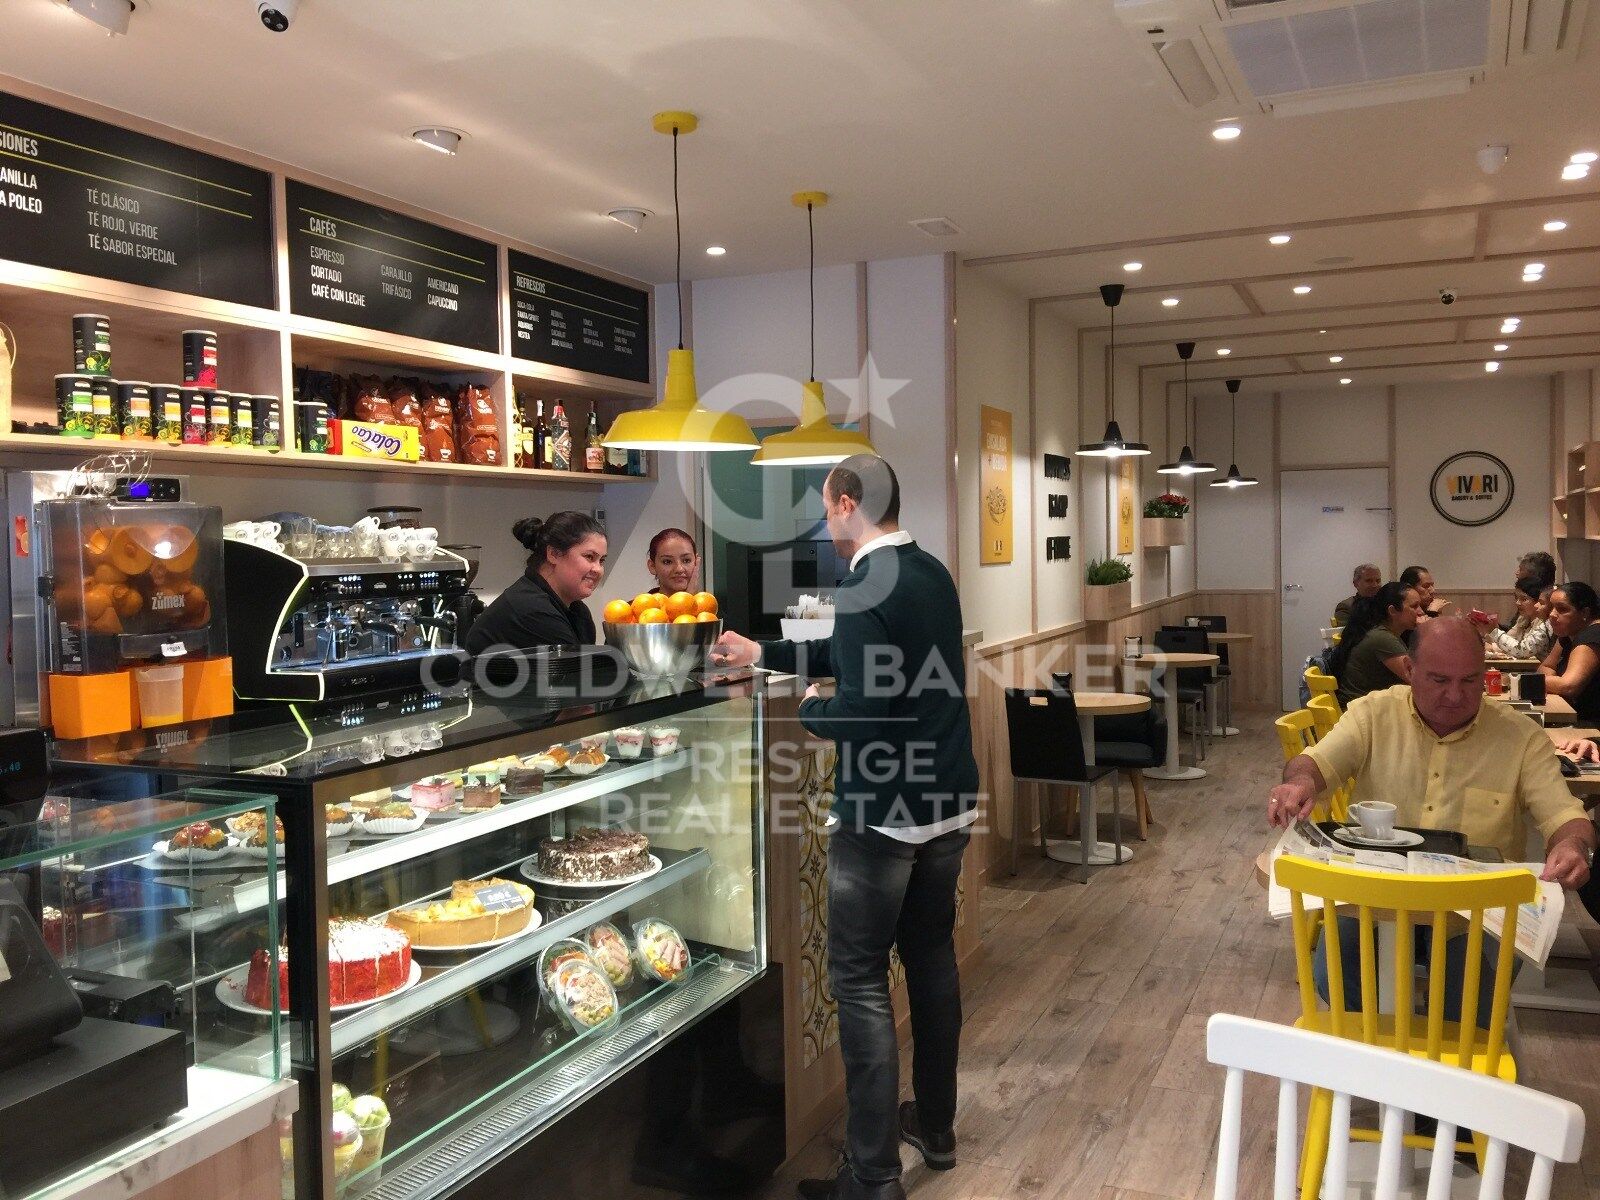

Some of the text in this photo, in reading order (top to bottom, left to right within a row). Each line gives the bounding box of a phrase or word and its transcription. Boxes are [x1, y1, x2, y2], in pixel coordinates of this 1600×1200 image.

[8, 191, 43, 214] POLEO
[86, 188, 140, 214] TÉ CLÁSICO
[87, 210, 100, 227] TÉ
[129, 218, 159, 240] VERDE
[309, 216, 337, 238] CAFÉS
[88, 233, 178, 266] TÉ SABOR ESPECIAL
[310, 245, 345, 266] ESPRESSO
[311, 264, 342, 283] CORTADO
[311, 283, 366, 307] CAFÉ CON LECHE
[427, 276, 459, 295] AMERICANO
[1445, 473, 1499, 495] VIVARI
